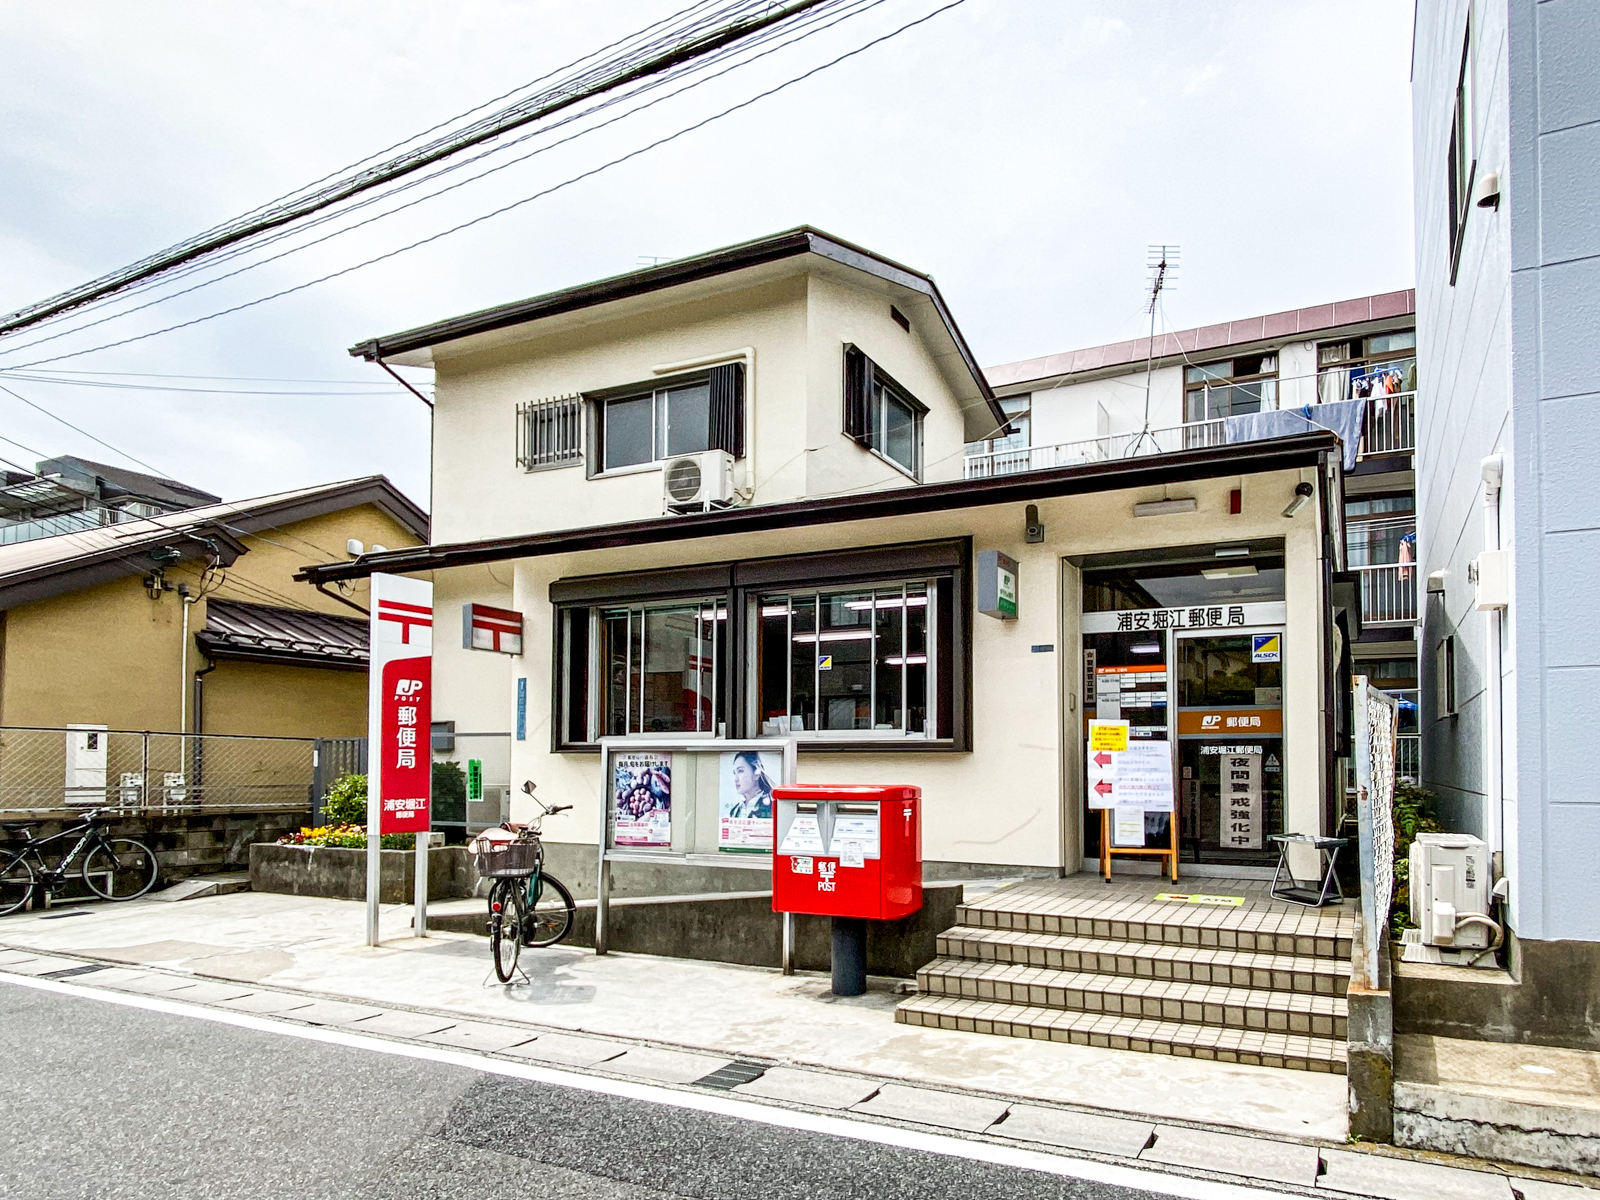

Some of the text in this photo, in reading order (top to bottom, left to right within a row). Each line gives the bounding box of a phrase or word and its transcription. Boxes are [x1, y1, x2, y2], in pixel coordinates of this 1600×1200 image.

[1117, 606, 1245, 631] 浦安堀江郵便局
[396, 679, 423, 695] JP
[1226, 716, 1261, 728] 郵便局
[396, 706, 417, 769] 郵便局
[1200, 745, 1263, 755] 浦安堀江郵便局
[383, 798, 427, 811] 浦安堀江
[1230, 757, 1251, 845] 夜間警戒強化中
[818, 861, 836, 873] 郵便
[818, 882, 836, 892] POST
